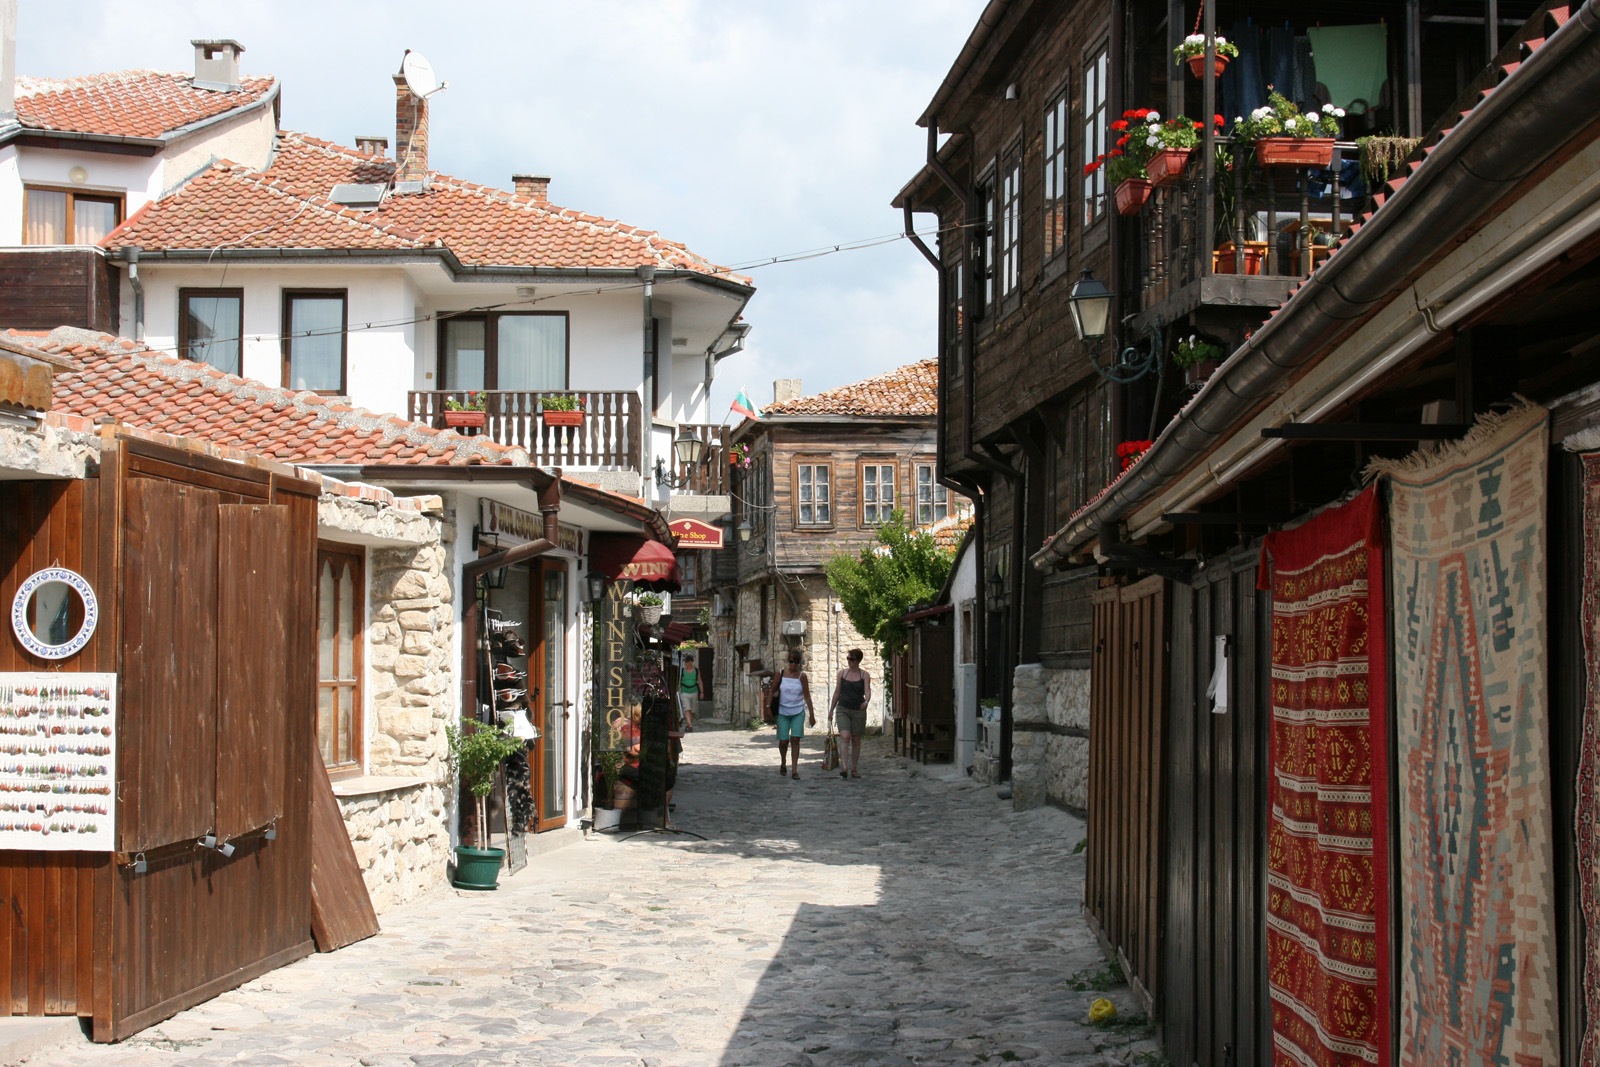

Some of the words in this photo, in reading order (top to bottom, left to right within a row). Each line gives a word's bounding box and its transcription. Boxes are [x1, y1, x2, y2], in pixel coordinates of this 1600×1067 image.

[689, 531, 707, 541] Shop
[620, 561, 669, 577] WINE
[606, 580, 628, 662] WINE
[606, 666, 625, 749] SHOP
